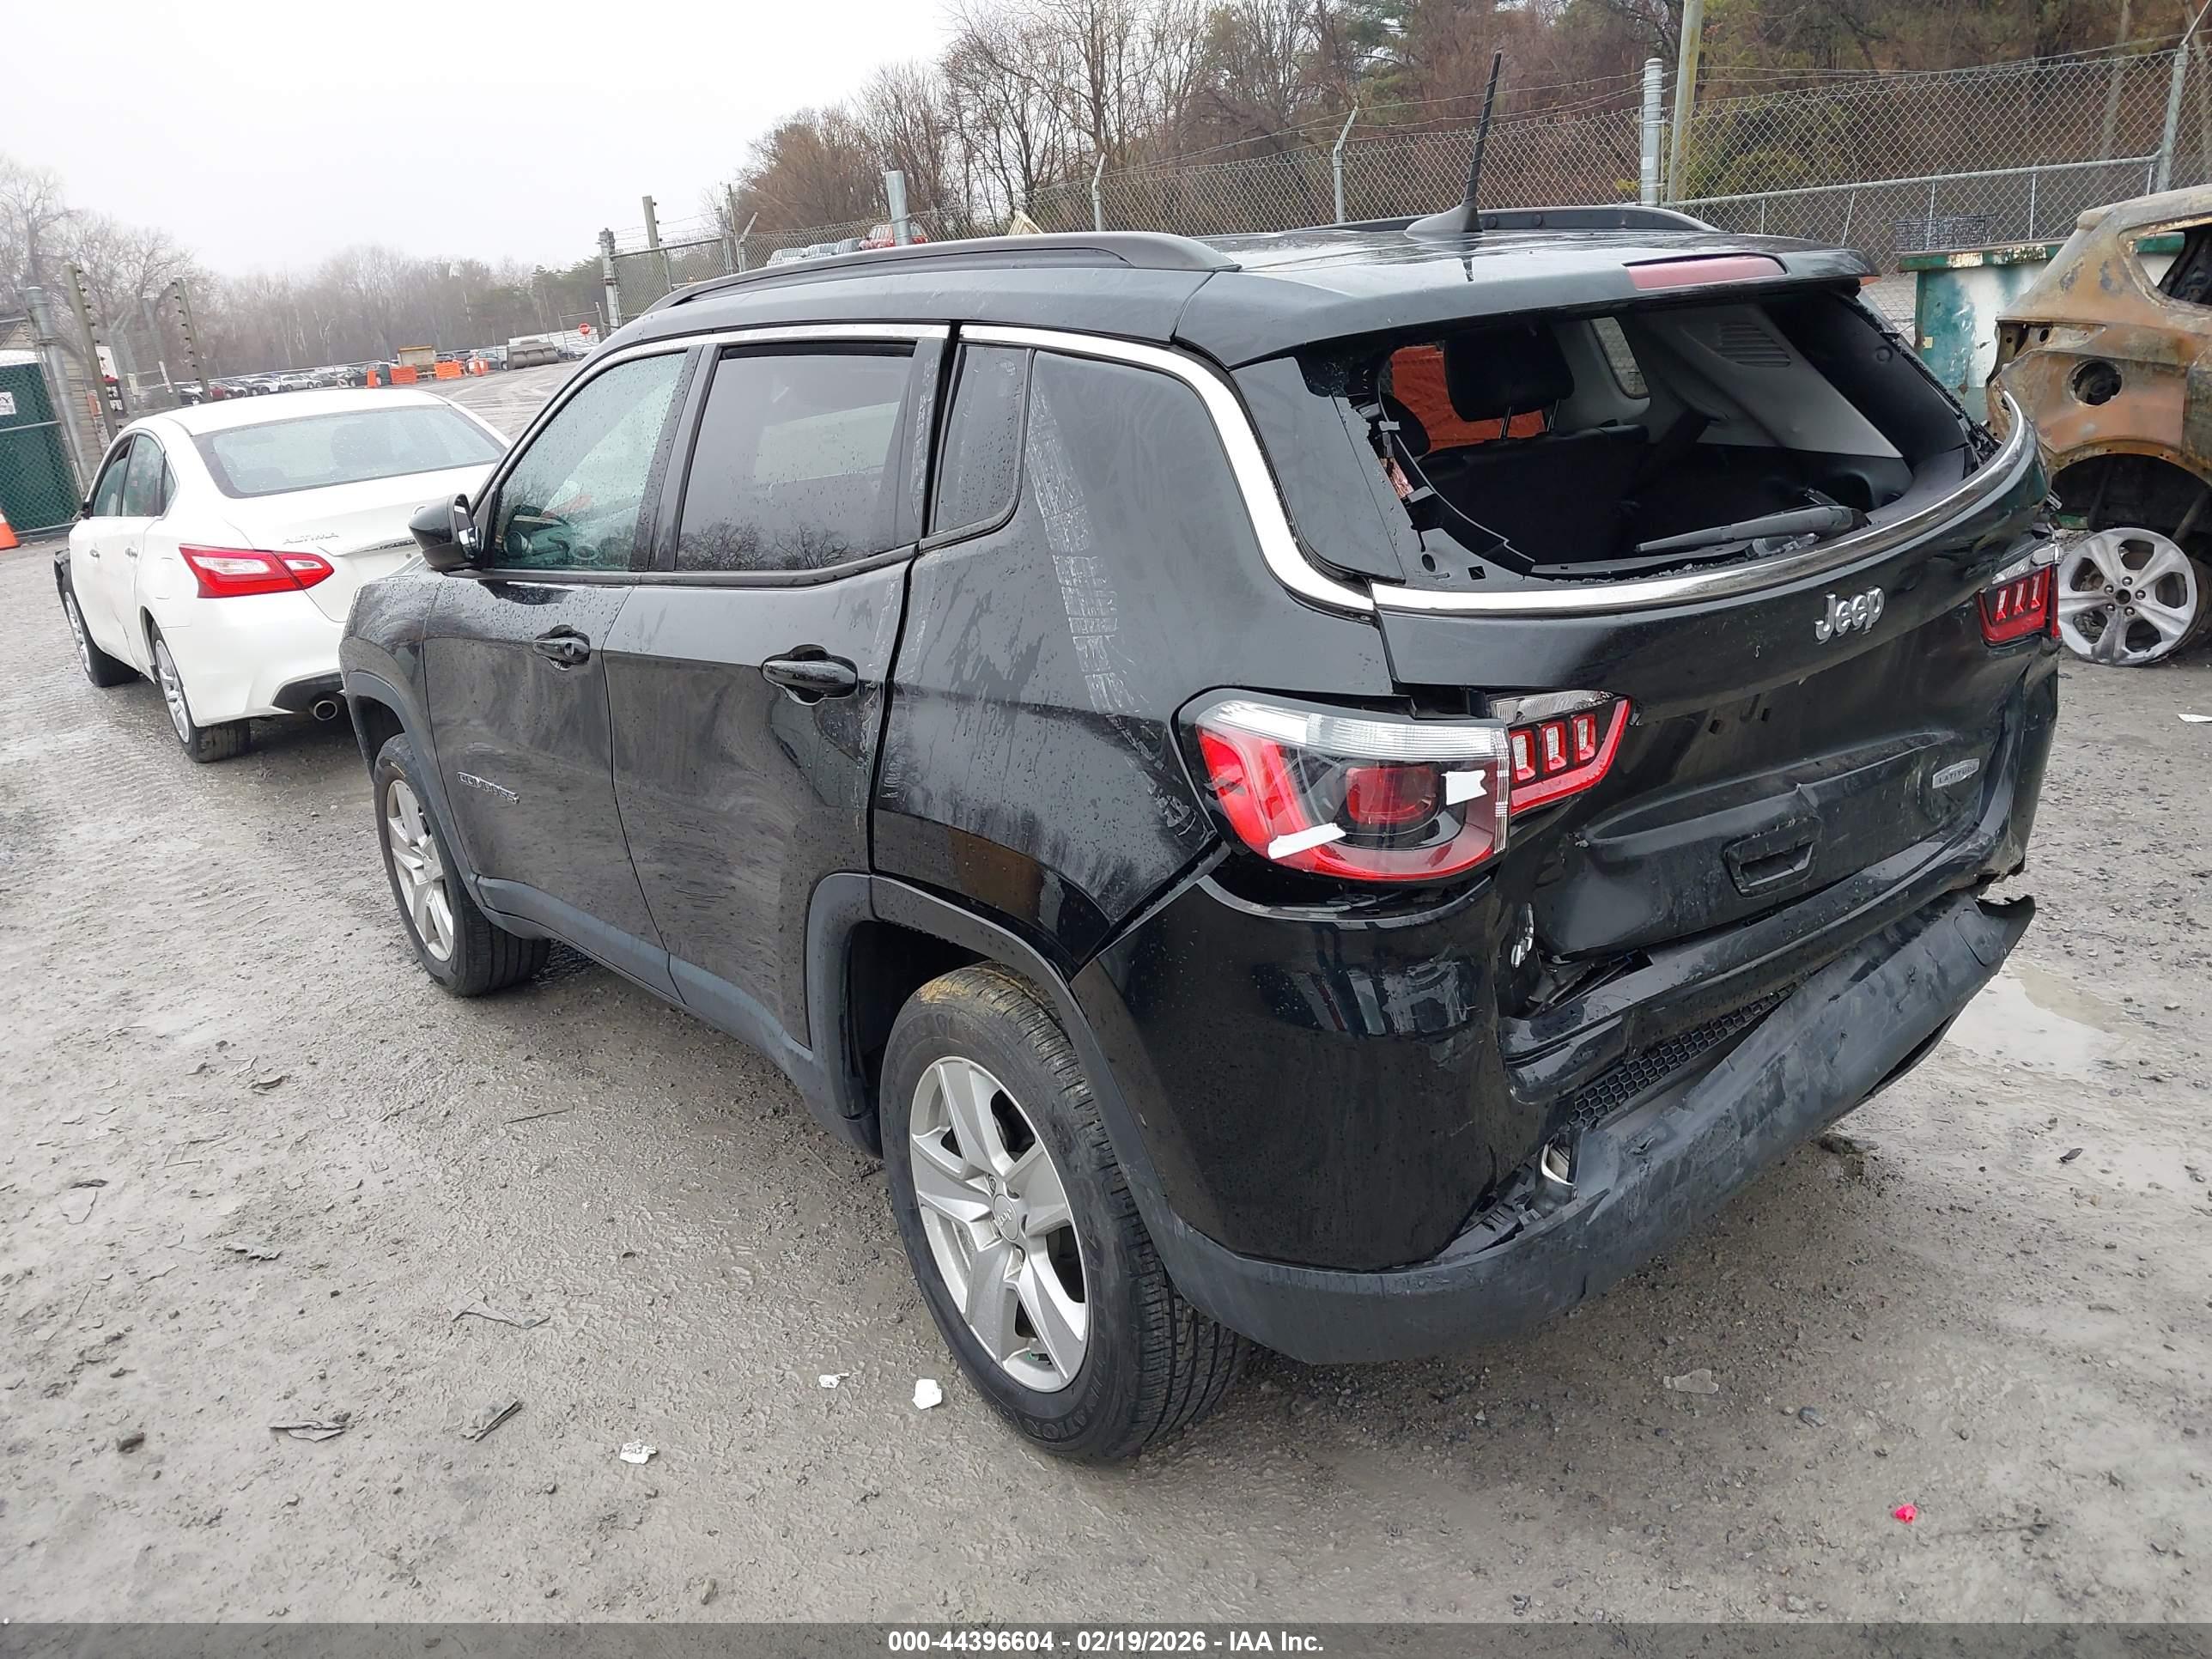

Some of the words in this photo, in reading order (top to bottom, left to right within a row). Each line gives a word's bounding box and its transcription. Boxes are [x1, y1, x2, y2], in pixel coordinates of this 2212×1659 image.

[1814, 585, 1885, 642] Jeep
[456, 770, 520, 805] COMPASS
[1938, 765, 1976, 783] LATITUD
